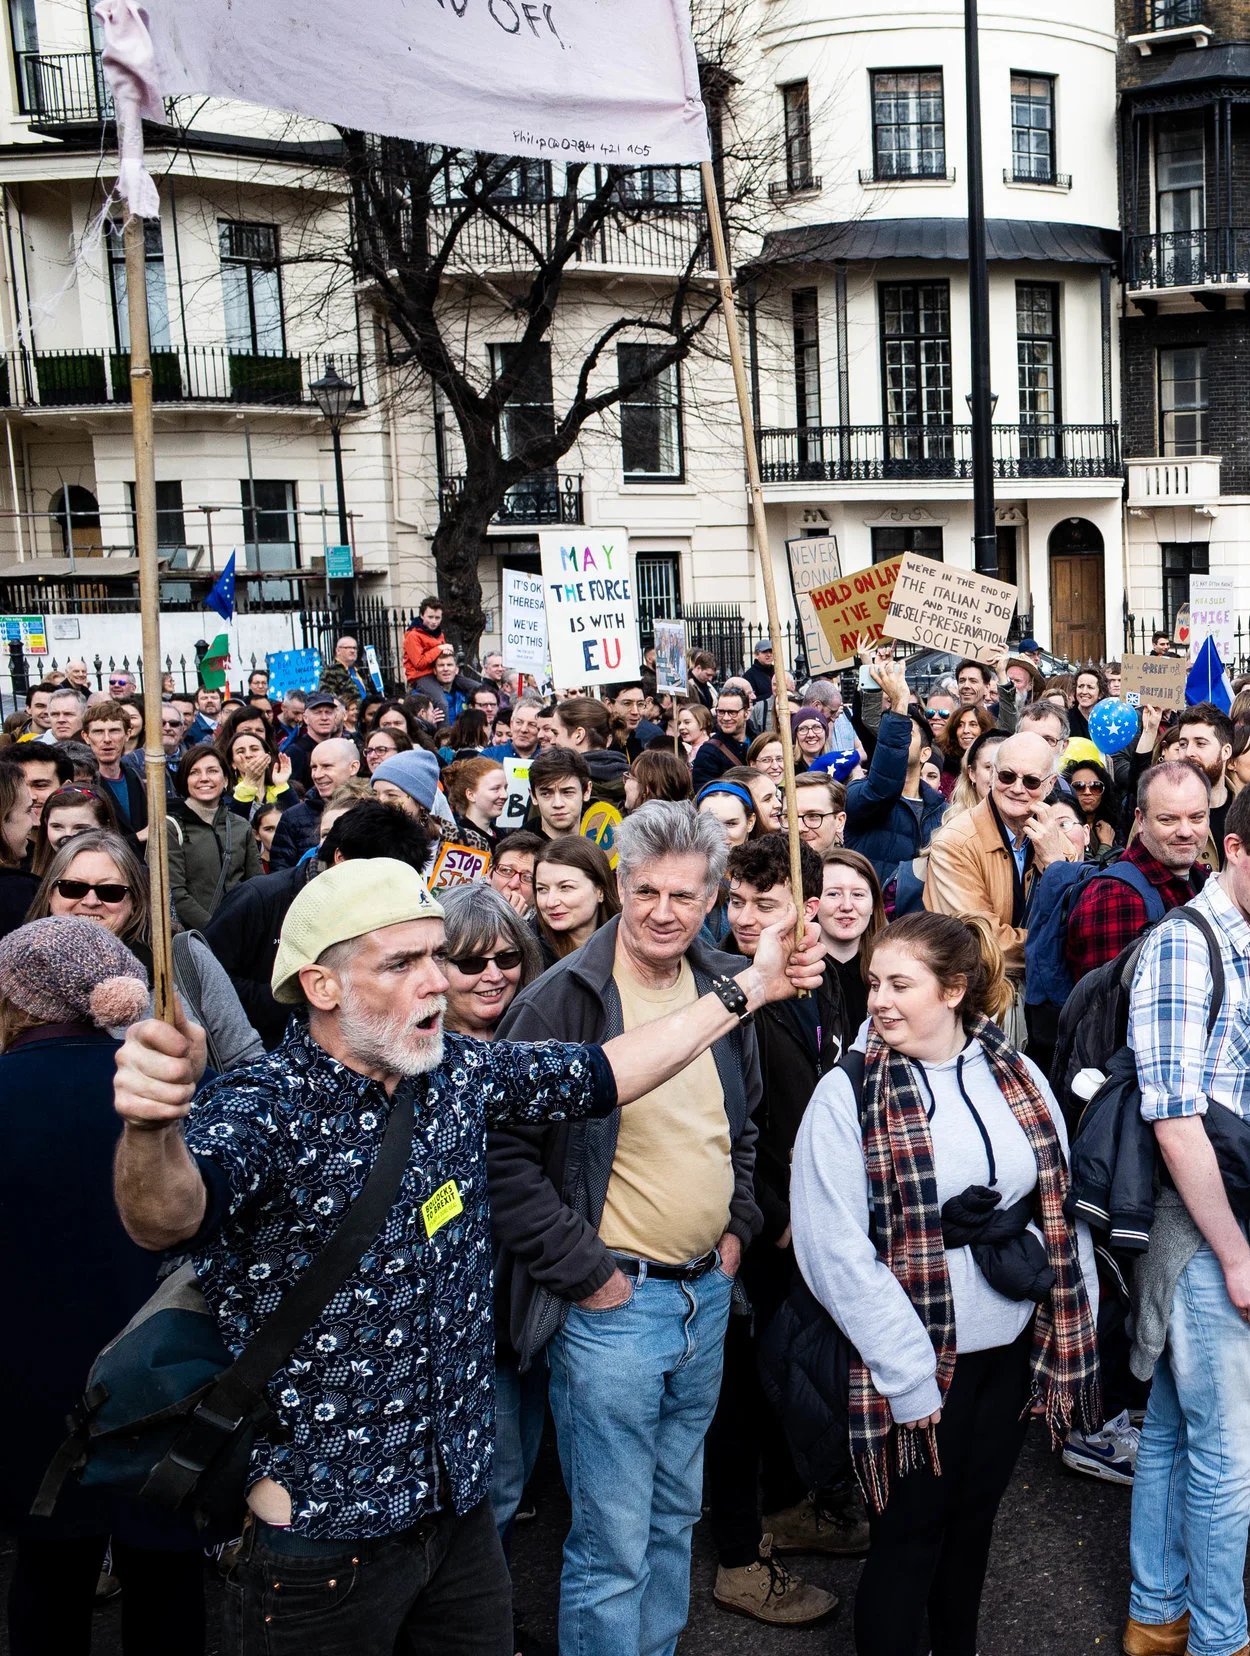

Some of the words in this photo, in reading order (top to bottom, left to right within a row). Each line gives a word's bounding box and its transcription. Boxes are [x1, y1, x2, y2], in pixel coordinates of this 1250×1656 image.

[600, 144, 620, 155] 421
[560, 545, 614, 572] MAY
[791, 542, 837, 566] NEVER
[513, 580, 528, 592] IT'S
[530, 583, 542, 594] OK
[550, 583, 586, 602] THE
[588, 580, 631, 601] FORCE
[854, 572, 876, 594] ON
[906, 561, 937, 577] WE'RE
[941, 573, 953, 581] IN
[956, 577, 976, 589] THE
[980, 585, 998, 596] END
[1000, 591, 1012, 601] OF
[508, 595, 545, 610] THERESA
[902, 575, 926, 594] THE
[933, 586, 980, 610] ITALIAN
[984, 602, 1011, 620] JOB
[569, 617, 585, 633] IS
[590, 613, 625, 629] WITH
[923, 599, 943, 611] AND
[947, 606, 968, 620] THIS
[972, 615, 982, 625] IS
[1192, 610, 1230, 625] TWICE
[513, 618, 538, 632] WE'VE
[507, 634, 524, 645] GOT
[526, 636, 543, 648] THIS
[912, 625, 984, 660] SOCIETY
[1194, 641, 1230, 656] OCE
[582, 638, 621, 672] EU
[445, 850, 482, 878] STOP
